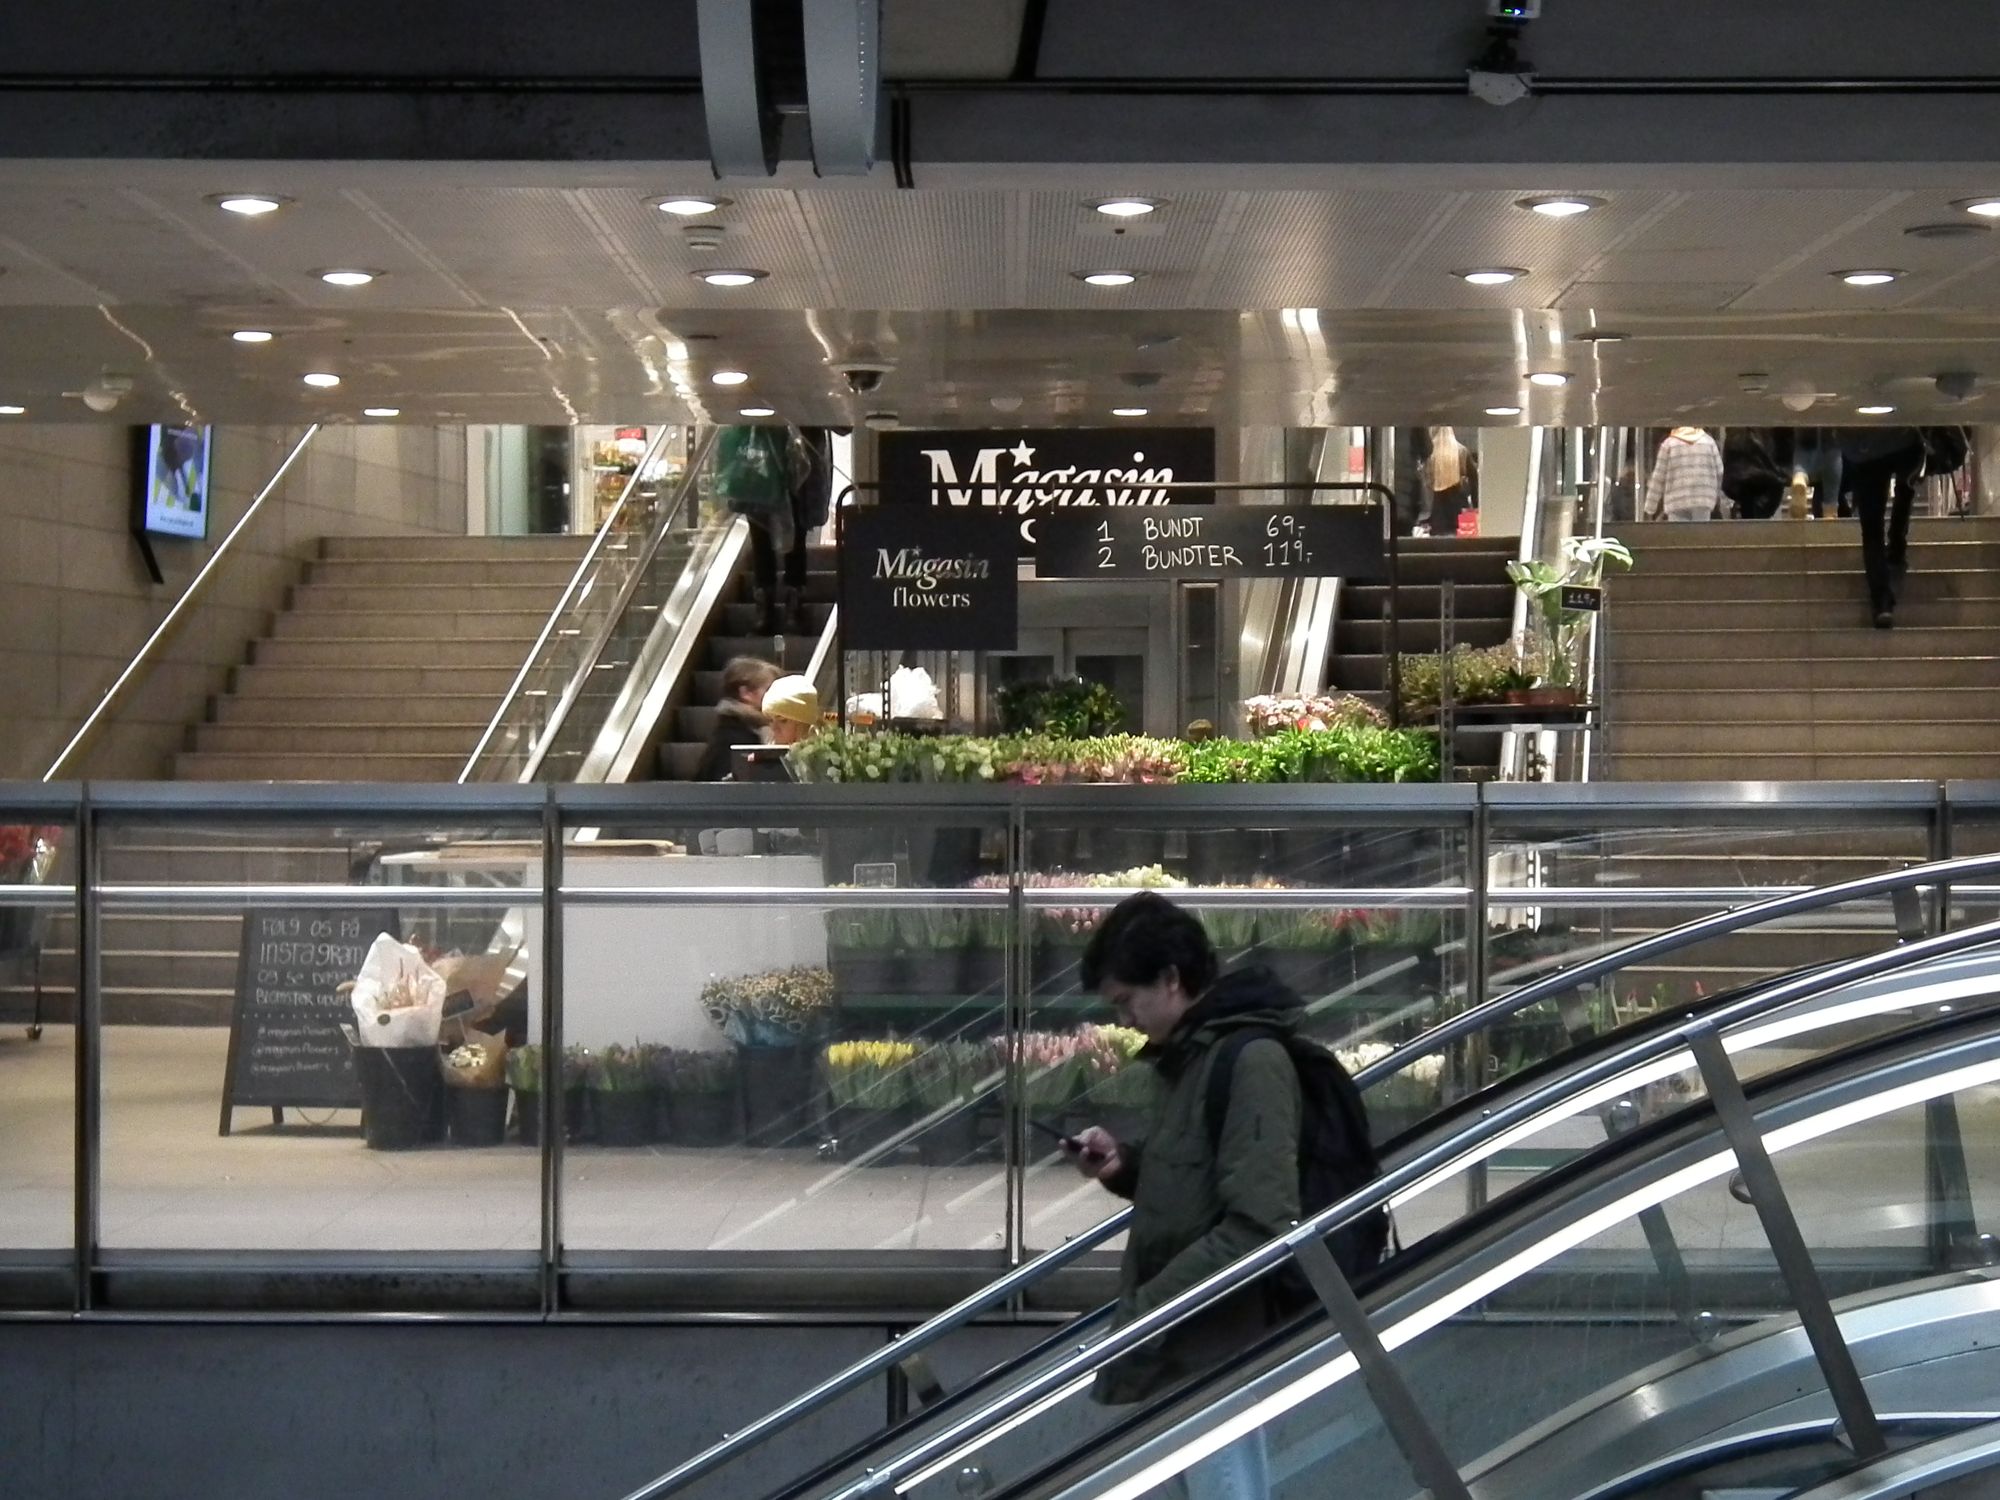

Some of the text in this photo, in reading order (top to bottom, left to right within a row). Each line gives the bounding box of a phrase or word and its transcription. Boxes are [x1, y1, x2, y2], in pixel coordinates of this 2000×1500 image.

[920, 440, 1174, 535] Magasin
[1096, 520, 1115, 542] 1
[1143, 517, 1203, 541] BUNDT
[872, 545, 990, 590] Magasin
[1097, 546, 1116, 568] 2
[1141, 544, 1243, 570] BUNDTER
[893, 586, 971, 607] flowers
